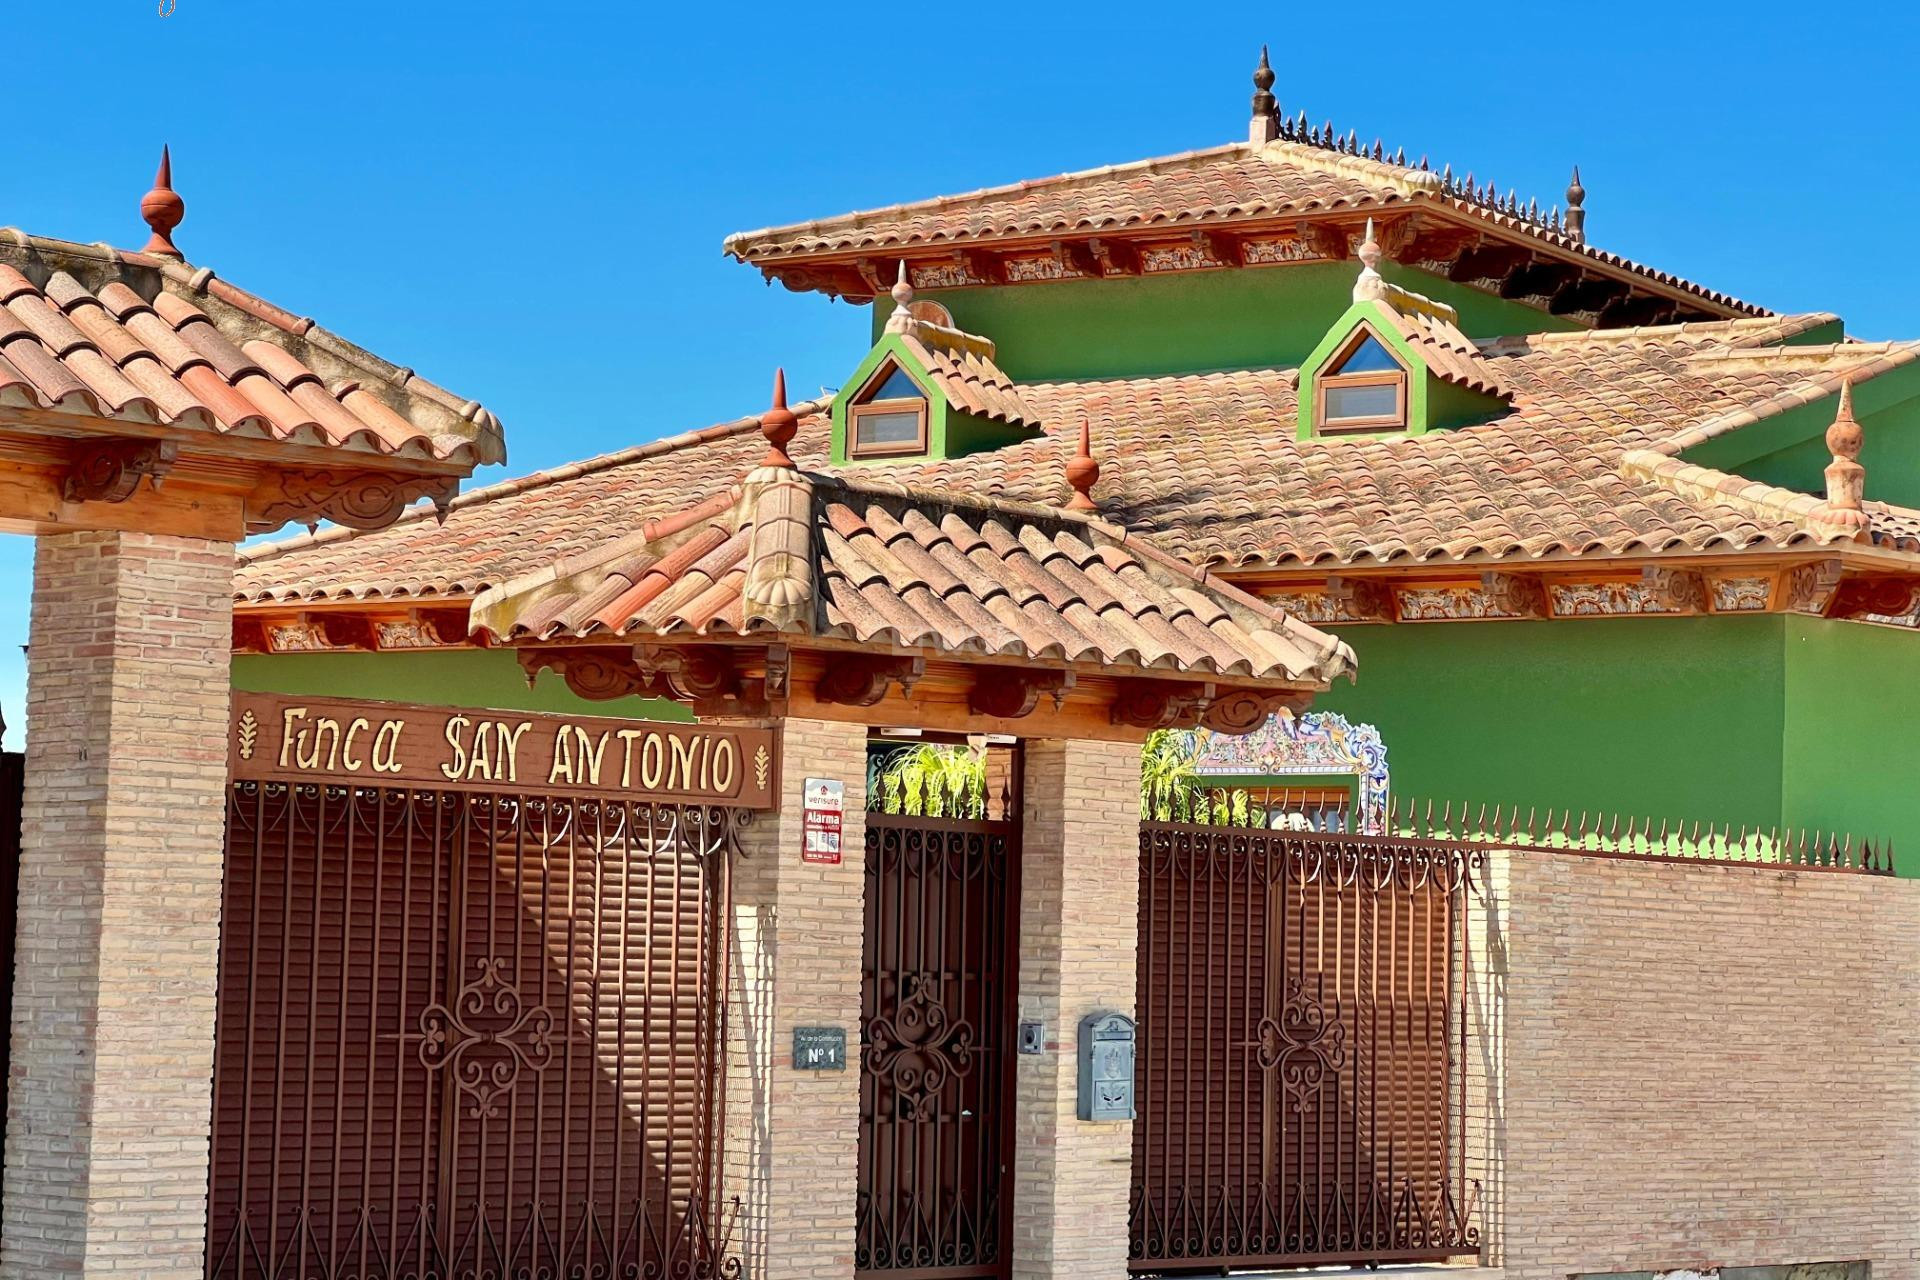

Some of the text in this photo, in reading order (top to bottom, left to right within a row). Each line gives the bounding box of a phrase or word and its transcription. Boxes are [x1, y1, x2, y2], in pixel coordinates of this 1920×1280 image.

[279, 707, 405, 773] Finca
[441, 713, 533, 783] SAN
[808, 796, 839, 806] verisure
[807, 811, 840, 825] Alarma
[828, 1048, 835, 1063] 1
